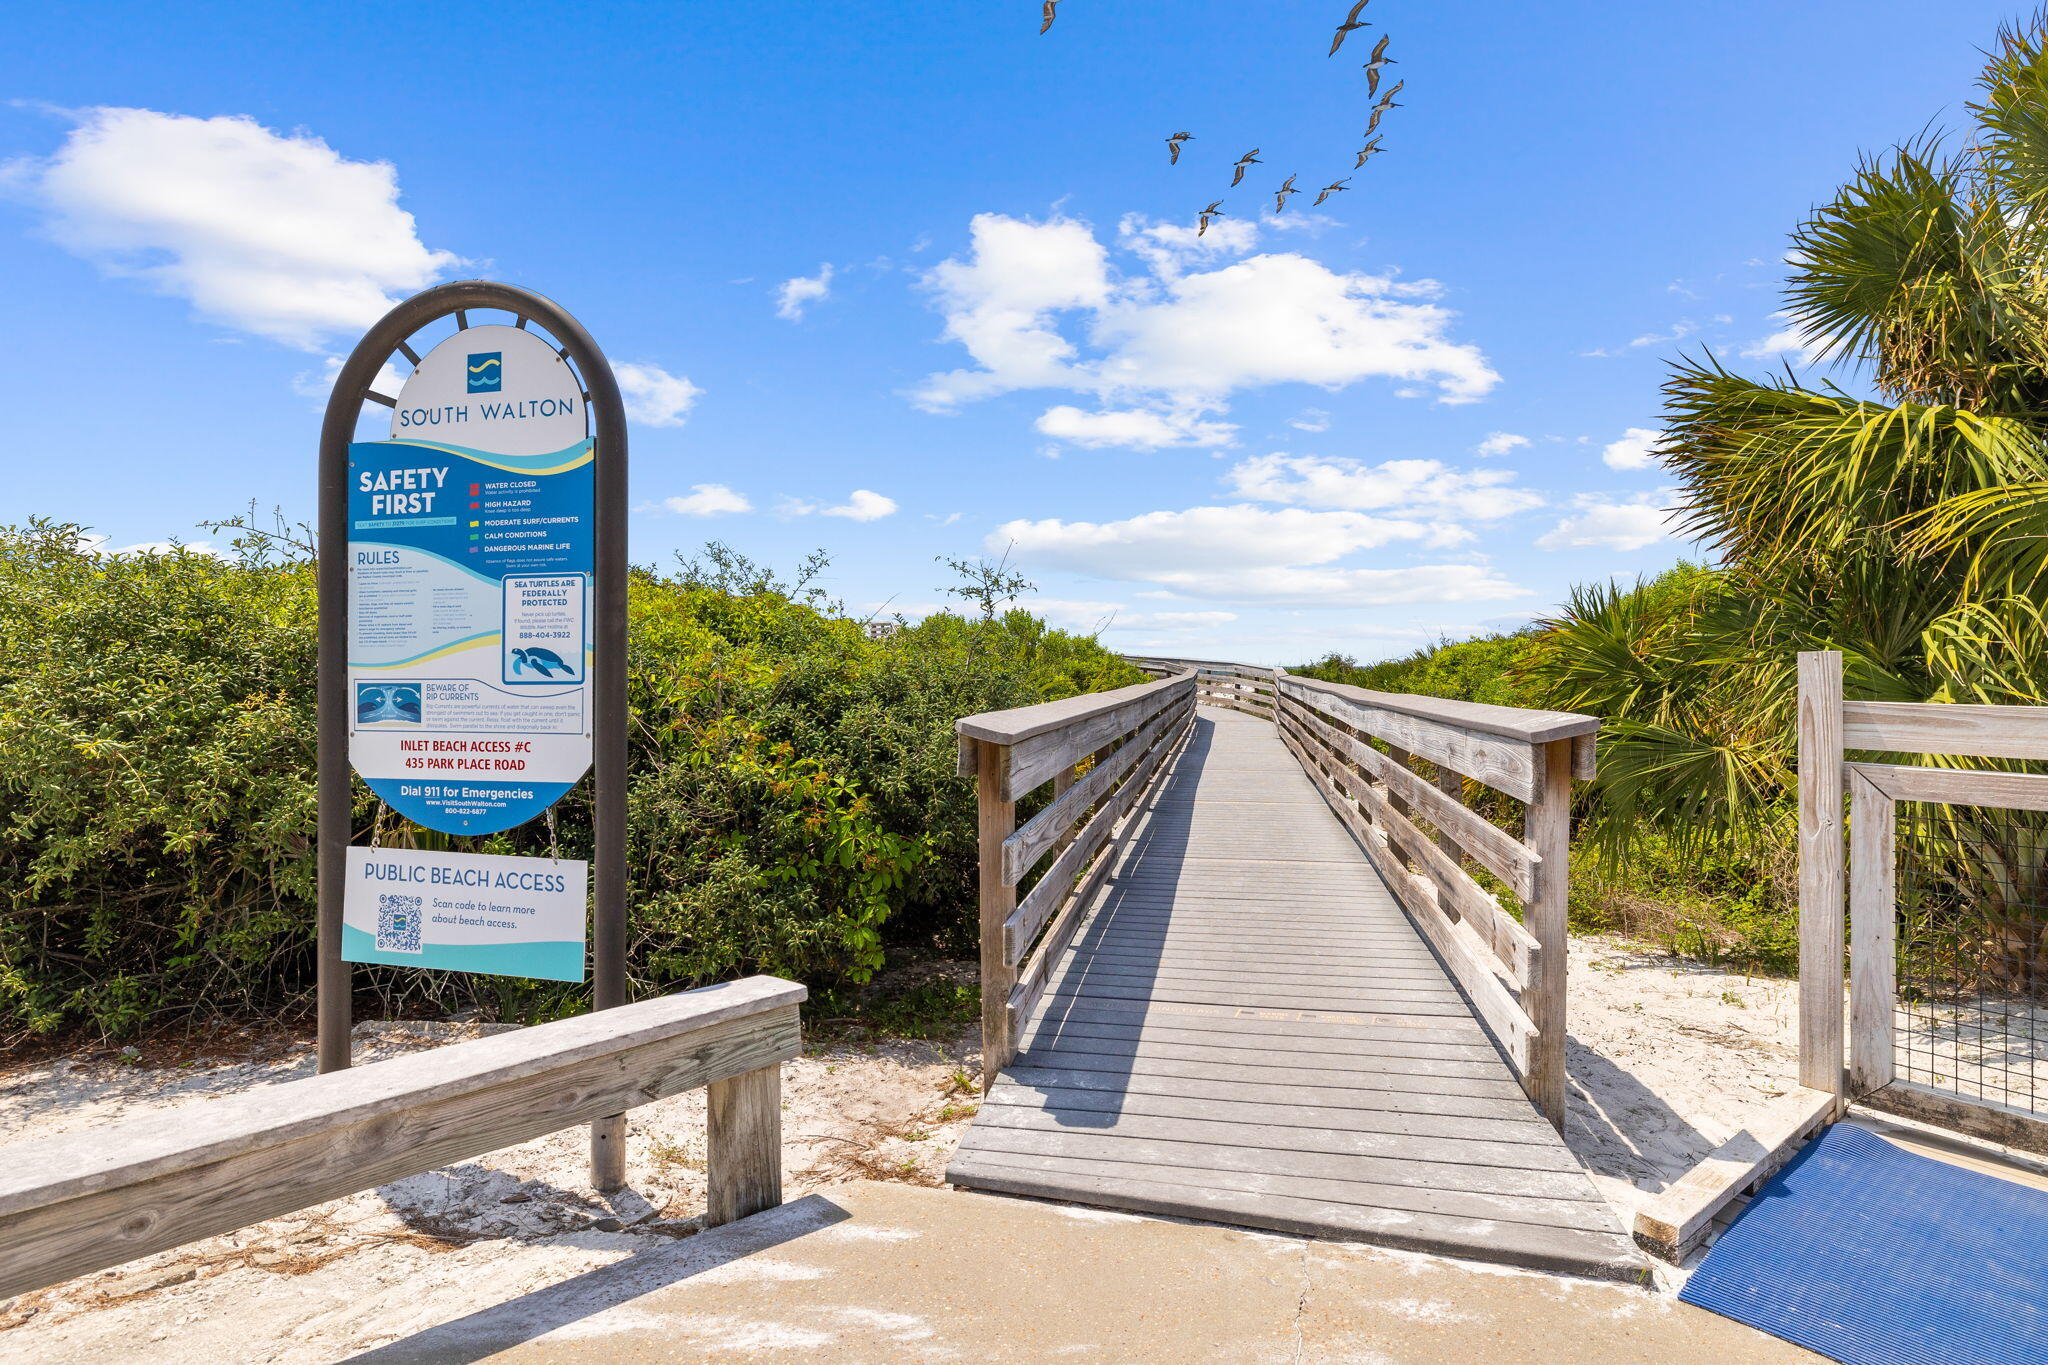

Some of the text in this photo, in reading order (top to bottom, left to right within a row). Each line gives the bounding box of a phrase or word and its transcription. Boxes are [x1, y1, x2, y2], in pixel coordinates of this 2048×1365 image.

[400, 397, 573, 427] SOUTH WALTON
[359, 467, 449, 492] SAFETY
[510, 480, 536, 488] CLOSED
[372, 492, 436, 515] FIRST
[503, 499, 531, 507] HAZARD
[485, 516, 579, 526] MODERATE SURF/CURRENTS
[505, 531, 547, 539] CONDITIONS
[528, 543, 554, 551] MARINE
[358, 551, 400, 565] RULES
[514, 579, 575, 588] SEA TURTLES ARE
[522, 589, 567, 597] FEDERALLY
[519, 631, 570, 639] 888-404-3922
[426, 683, 469, 692] BEWARE OF
[426, 692, 479, 701] RIP CURRENTS
[400, 740, 531, 753] INLET BEACH ACCESS #C
[405, 757, 525, 771] 435 PARK PLACE ROAD
[401, 785, 534, 800] Dial 911 for Emergencies
[426, 800, 507, 808] www.VisitSouthWalton.com
[364, 862, 566, 893] PUBLIC BEACH ACCESS
[432, 898, 536, 915] Scan code to learn more
[432, 915, 518, 929] about beach access.
